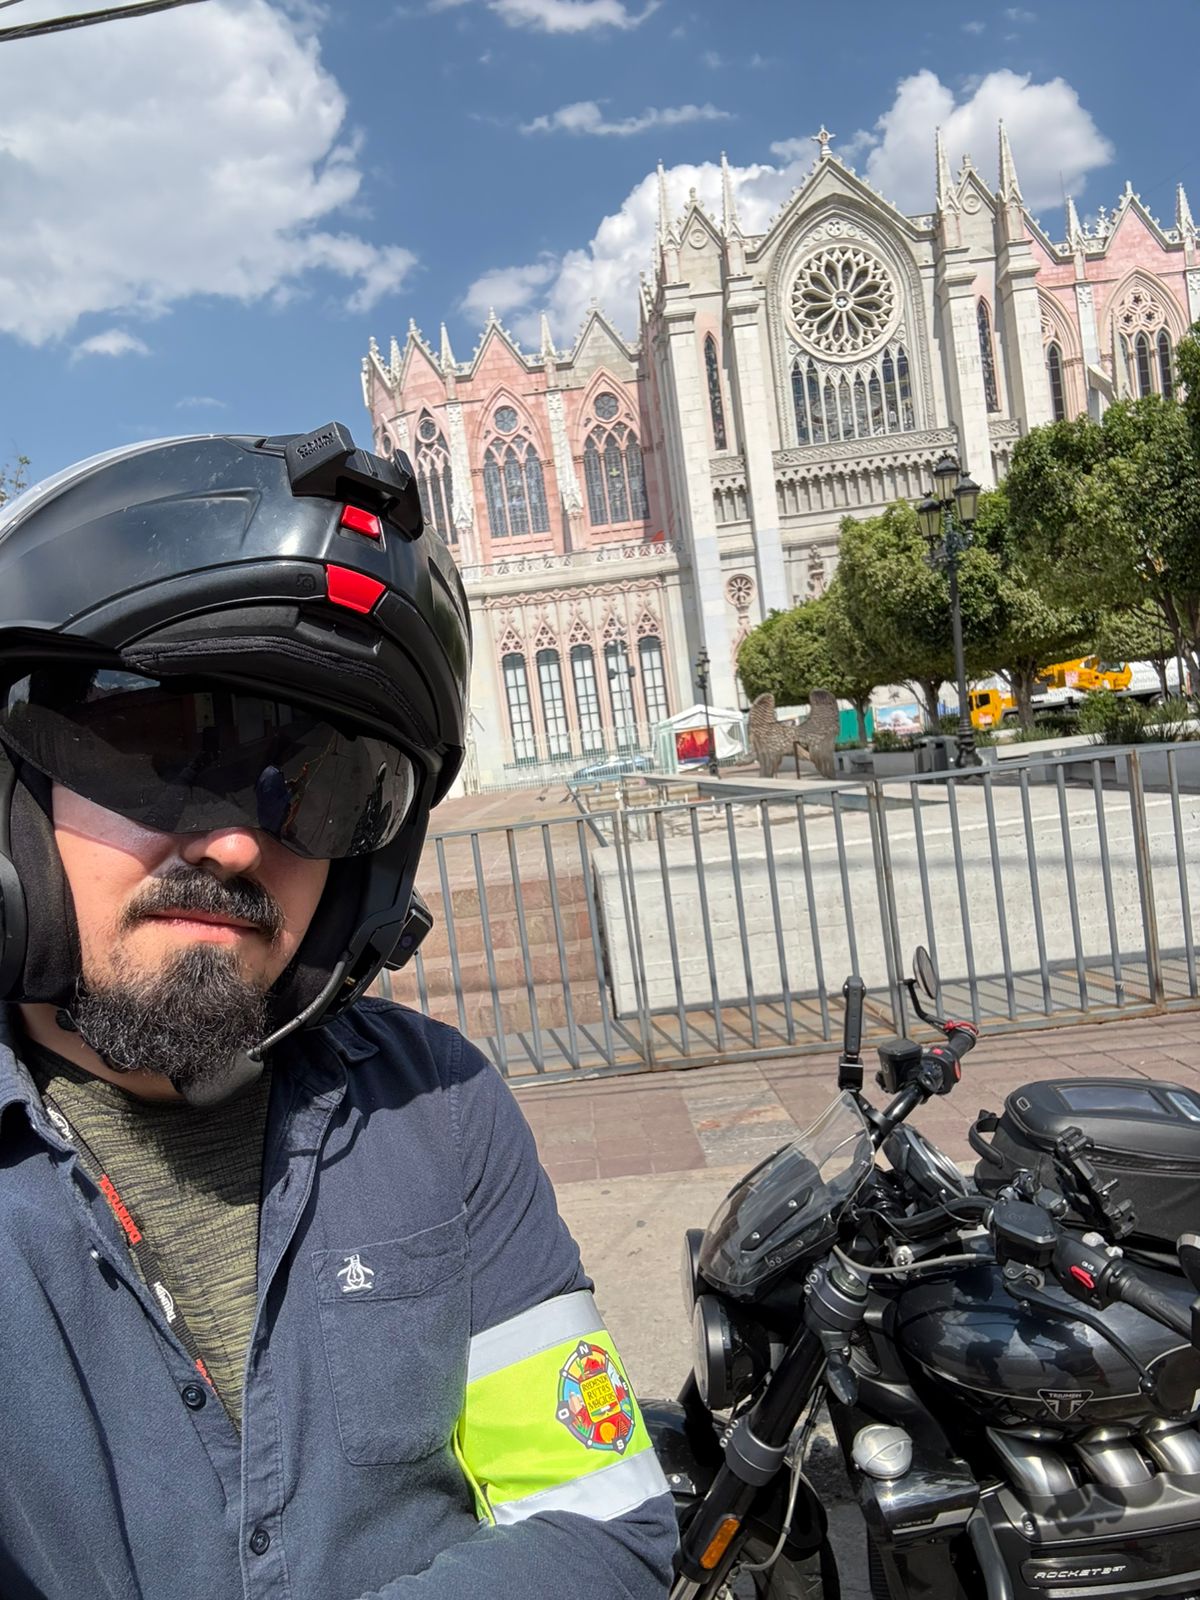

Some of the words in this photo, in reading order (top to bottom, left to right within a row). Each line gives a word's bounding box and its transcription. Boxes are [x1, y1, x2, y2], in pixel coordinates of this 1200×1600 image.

[99, 1173, 142, 1244] DATATOOL
[153, 1281, 177, 1324] TRIUMPH
[579, 1345, 589, 1355] N
[558, 1408, 569, 1420] O
[616, 1439, 625, 1450] S
